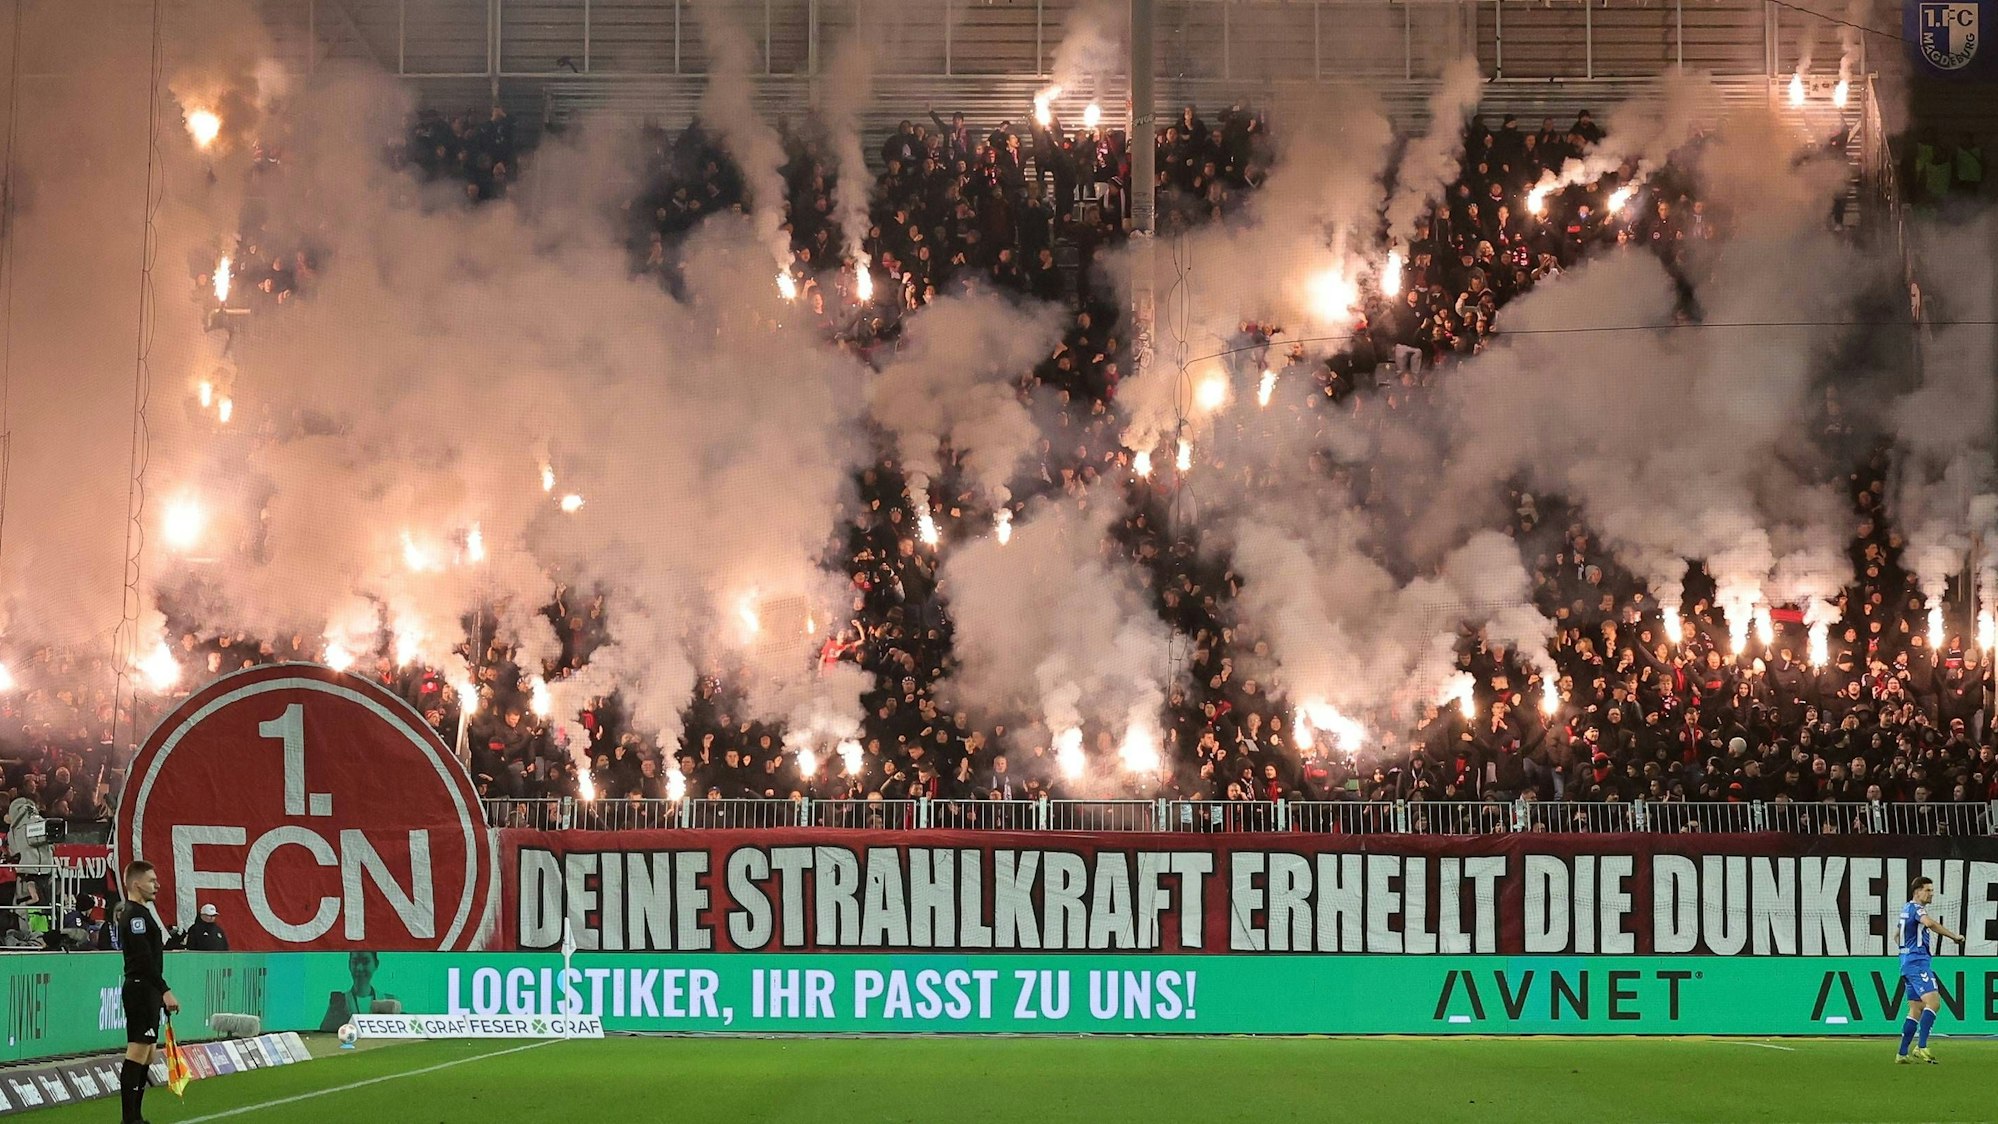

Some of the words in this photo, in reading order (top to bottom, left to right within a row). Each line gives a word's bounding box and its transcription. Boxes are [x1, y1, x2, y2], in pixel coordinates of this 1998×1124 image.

[1923, 32, 1975, 66] MAGDEBURG
[259, 704, 332, 816] 1.
[53, 856, 106, 879] NLAND
[172, 825, 435, 943] FCN
[519, 848, 711, 951] DEINE
[727, 847, 1213, 950] STRAHLKRAFT
[1230, 851, 1507, 954] ERHELLT
[1524, 855, 1635, 954] DIE
[447, 967, 733, 1025] LOGISTIKER,
[752, 969, 836, 1018] IHR
[854, 969, 998, 1019] PASST
[1013, 969, 1070, 1019] ZU
[1089, 969, 1198, 1020] UNS!
[357, 1019, 408, 1034] FESER
[425, 1019, 466, 1034] GRAF
[469, 1019, 528, 1034] FESER
[550, 1020, 600, 1034] GRAF
